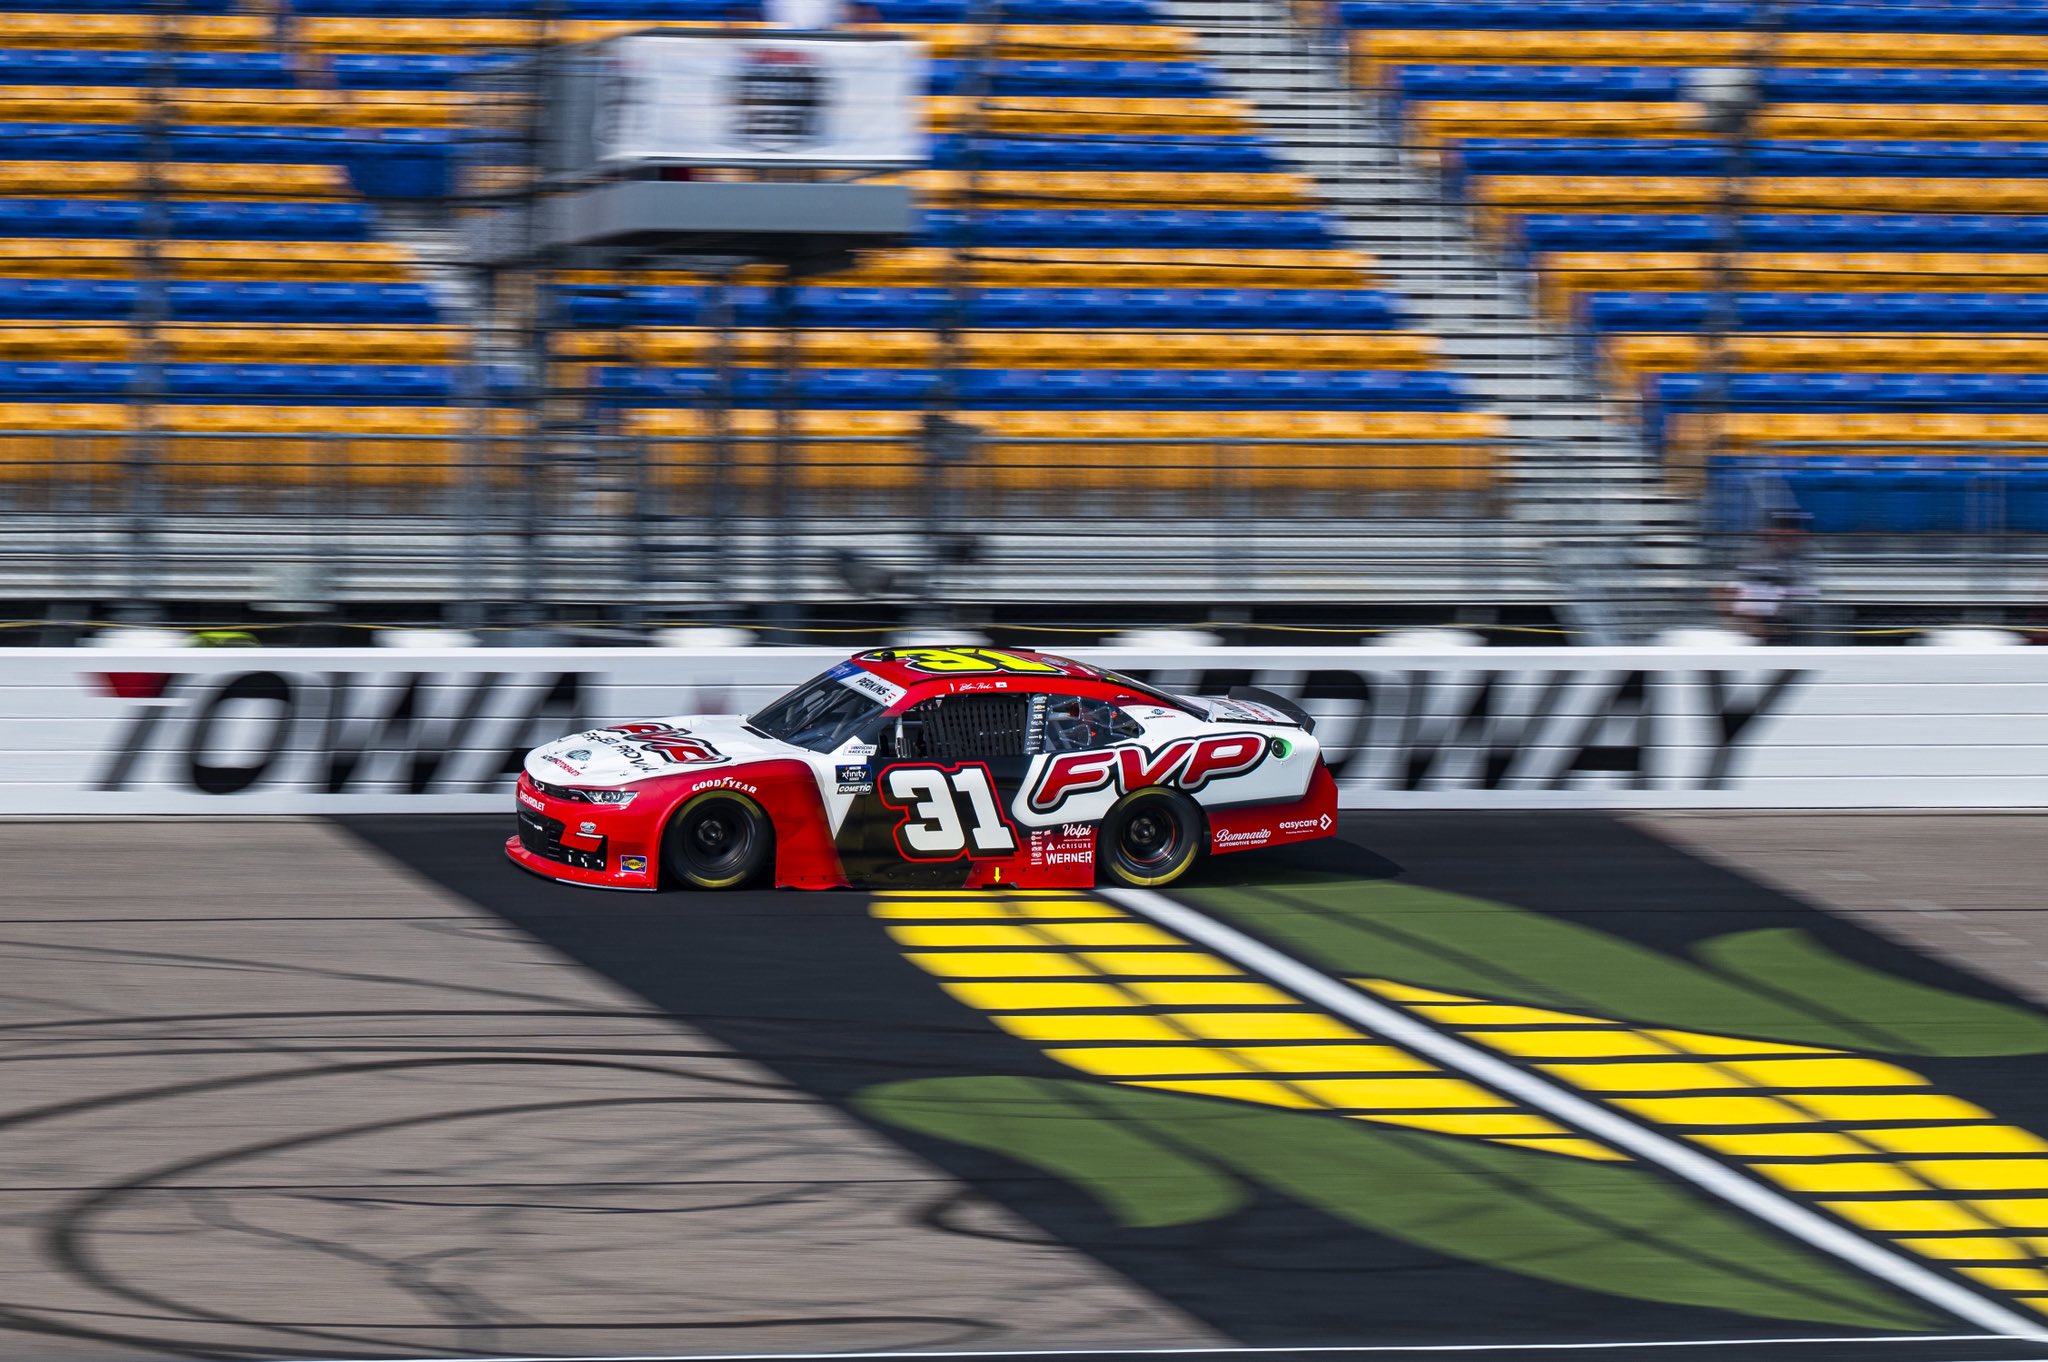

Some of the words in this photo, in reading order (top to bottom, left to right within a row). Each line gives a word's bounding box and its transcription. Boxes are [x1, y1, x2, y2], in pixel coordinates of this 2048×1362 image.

[862, 648, 1060, 673] 31
[855, 677, 890, 696] PERKINS
[598, 722, 733, 764] FVP
[841, 769, 867, 779] xfinity
[1030, 732, 1268, 812] FVP
[691, 777, 757, 794] GOODYEAR
[838, 783, 871, 792] COMETIC
[519, 790, 546, 812] CHEVROLET
[889, 768, 1015, 851] 31
[1062, 823, 1092, 839] Volpi
[1279, 819, 1319, 830] easycare
[1214, 828, 1272, 843] Bommarito
[1219, 840, 1250, 848] AUTOMOTIVE
[1045, 850, 1093, 865] WERNER
